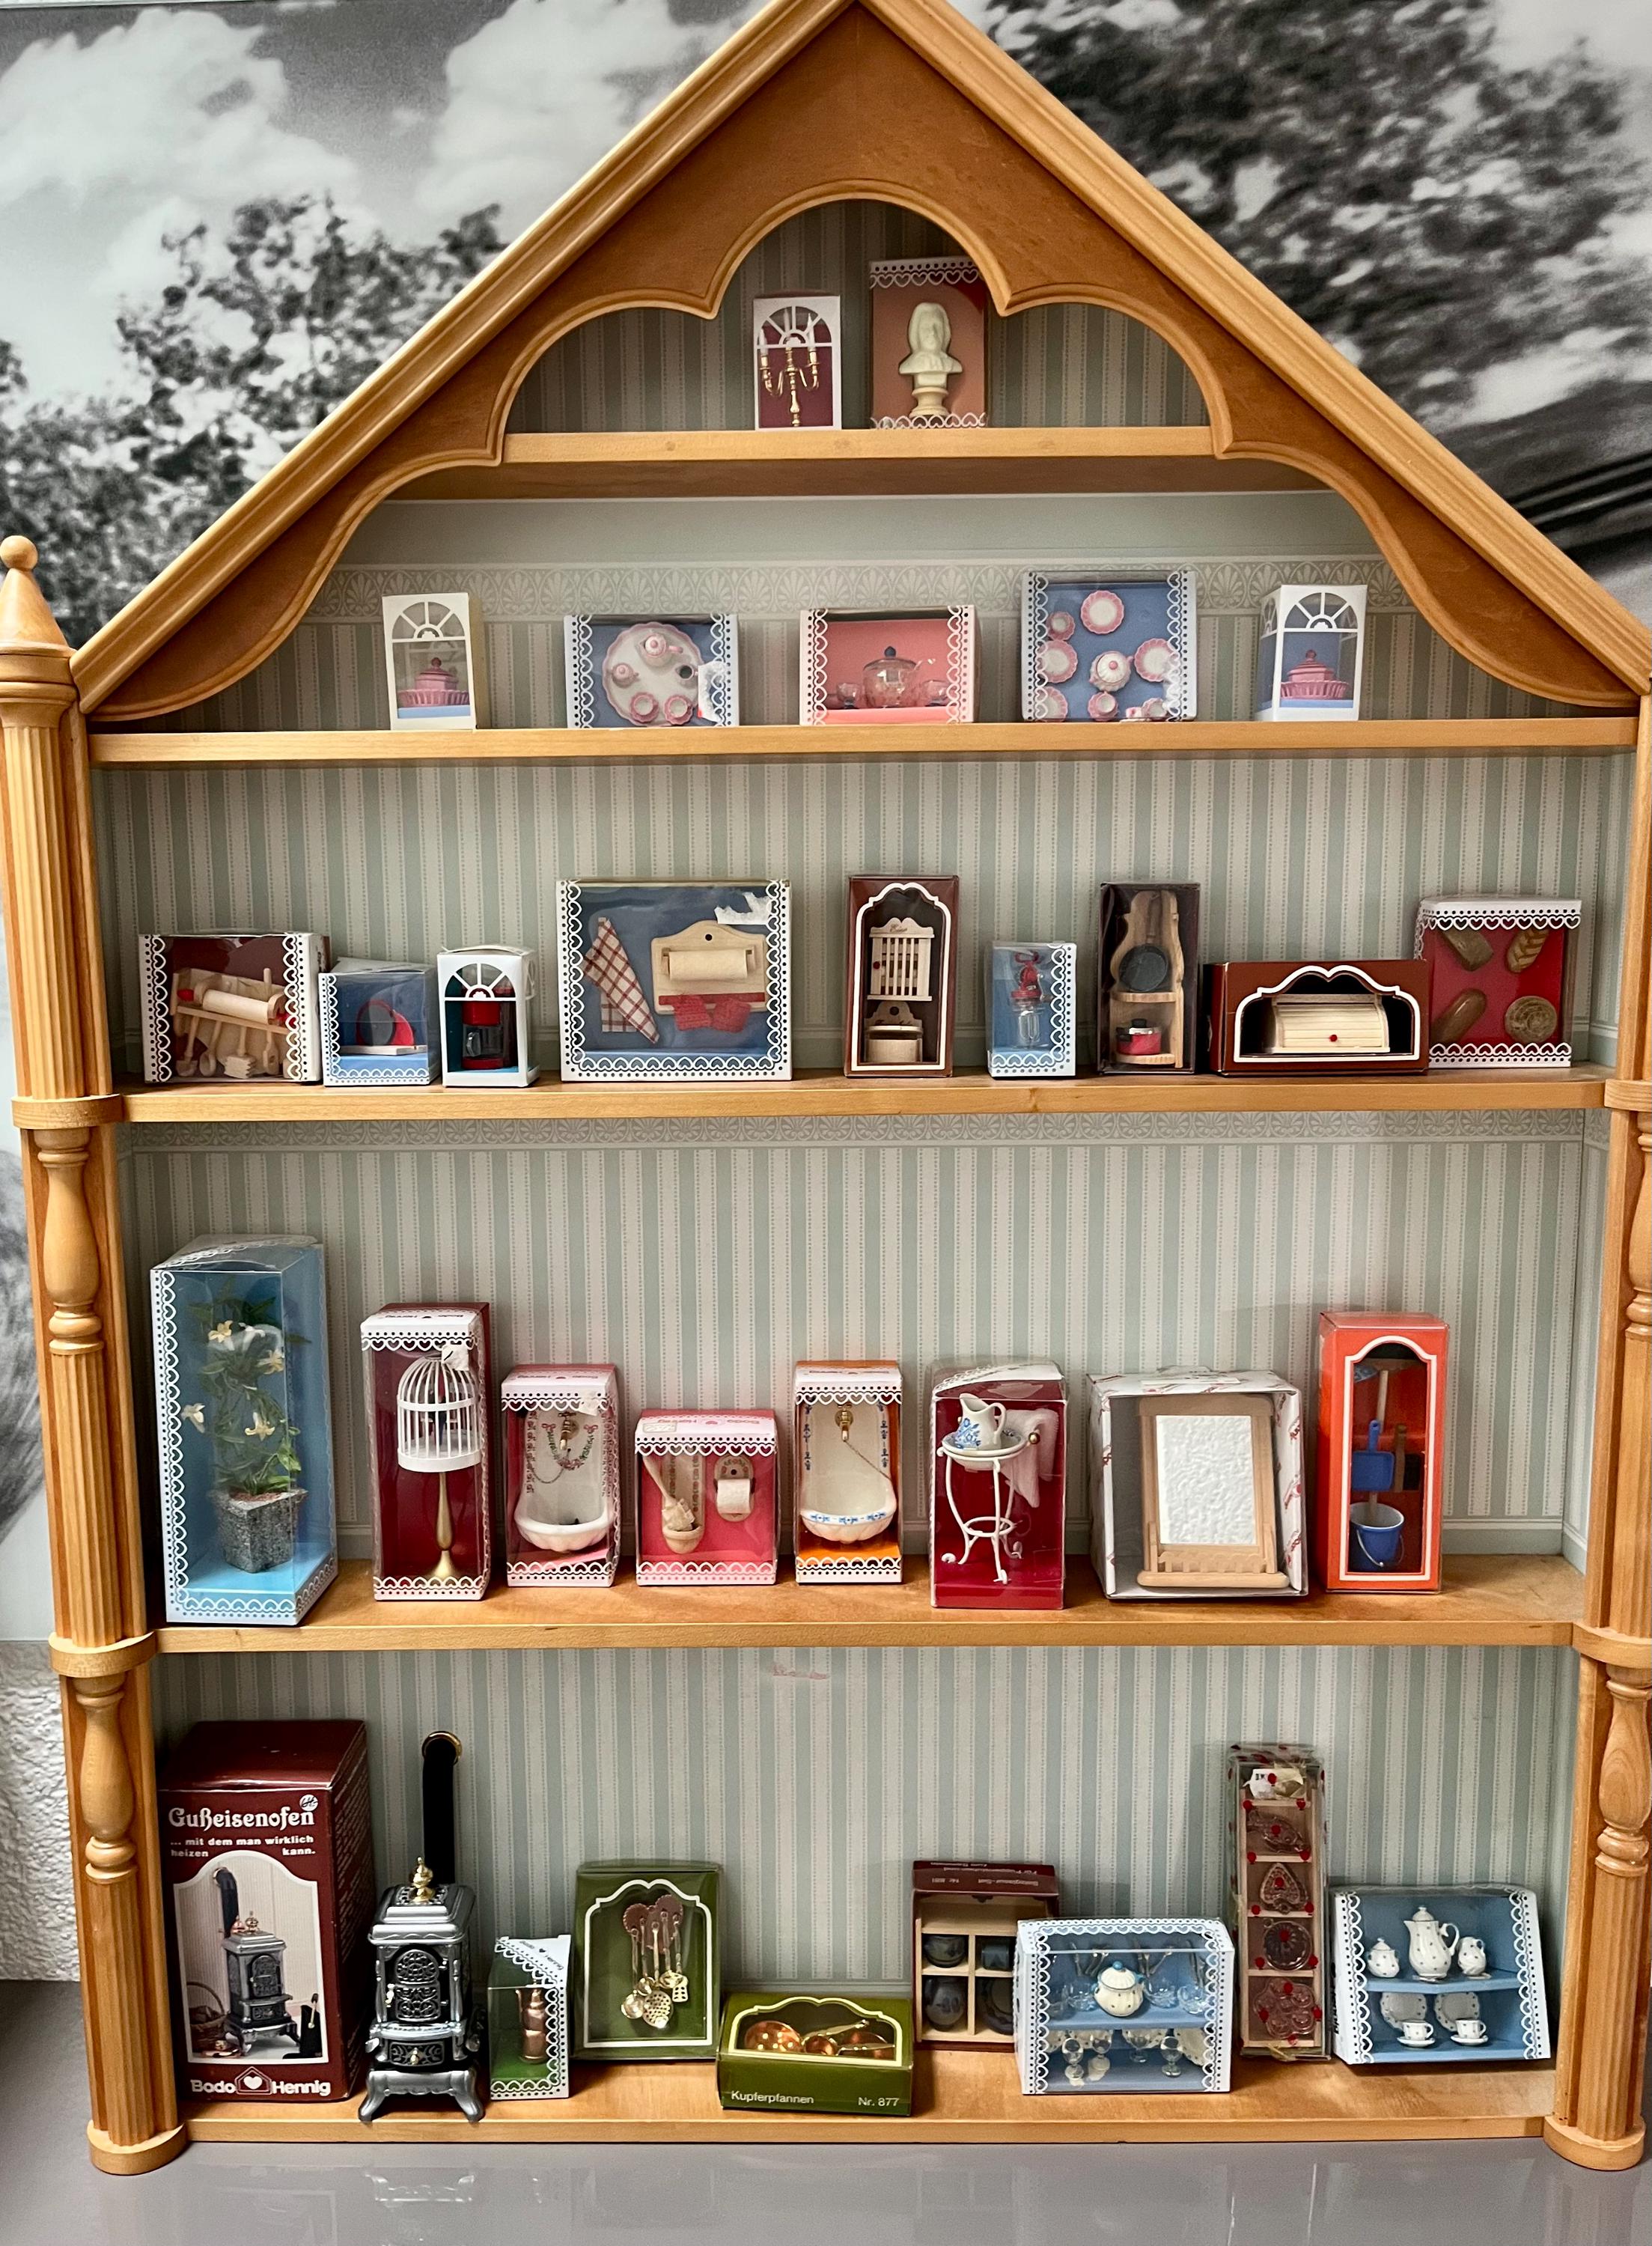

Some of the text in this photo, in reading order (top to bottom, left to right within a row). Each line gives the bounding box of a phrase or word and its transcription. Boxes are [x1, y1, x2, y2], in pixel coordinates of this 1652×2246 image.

[168, 1807, 315, 1831] Gußeisenofen
[185, 1837, 204, 1846] mit
[207, 1837, 233, 1846] dem
[264, 1835, 314, 1845] wirklich
[171, 1847, 316, 1858] heizen kann.
[190, 2079, 332, 2096] Bodo Hennig
[731, 2090, 814, 2105] Kupferpfannen
[857, 2096, 900, 2107] Nr. 877
